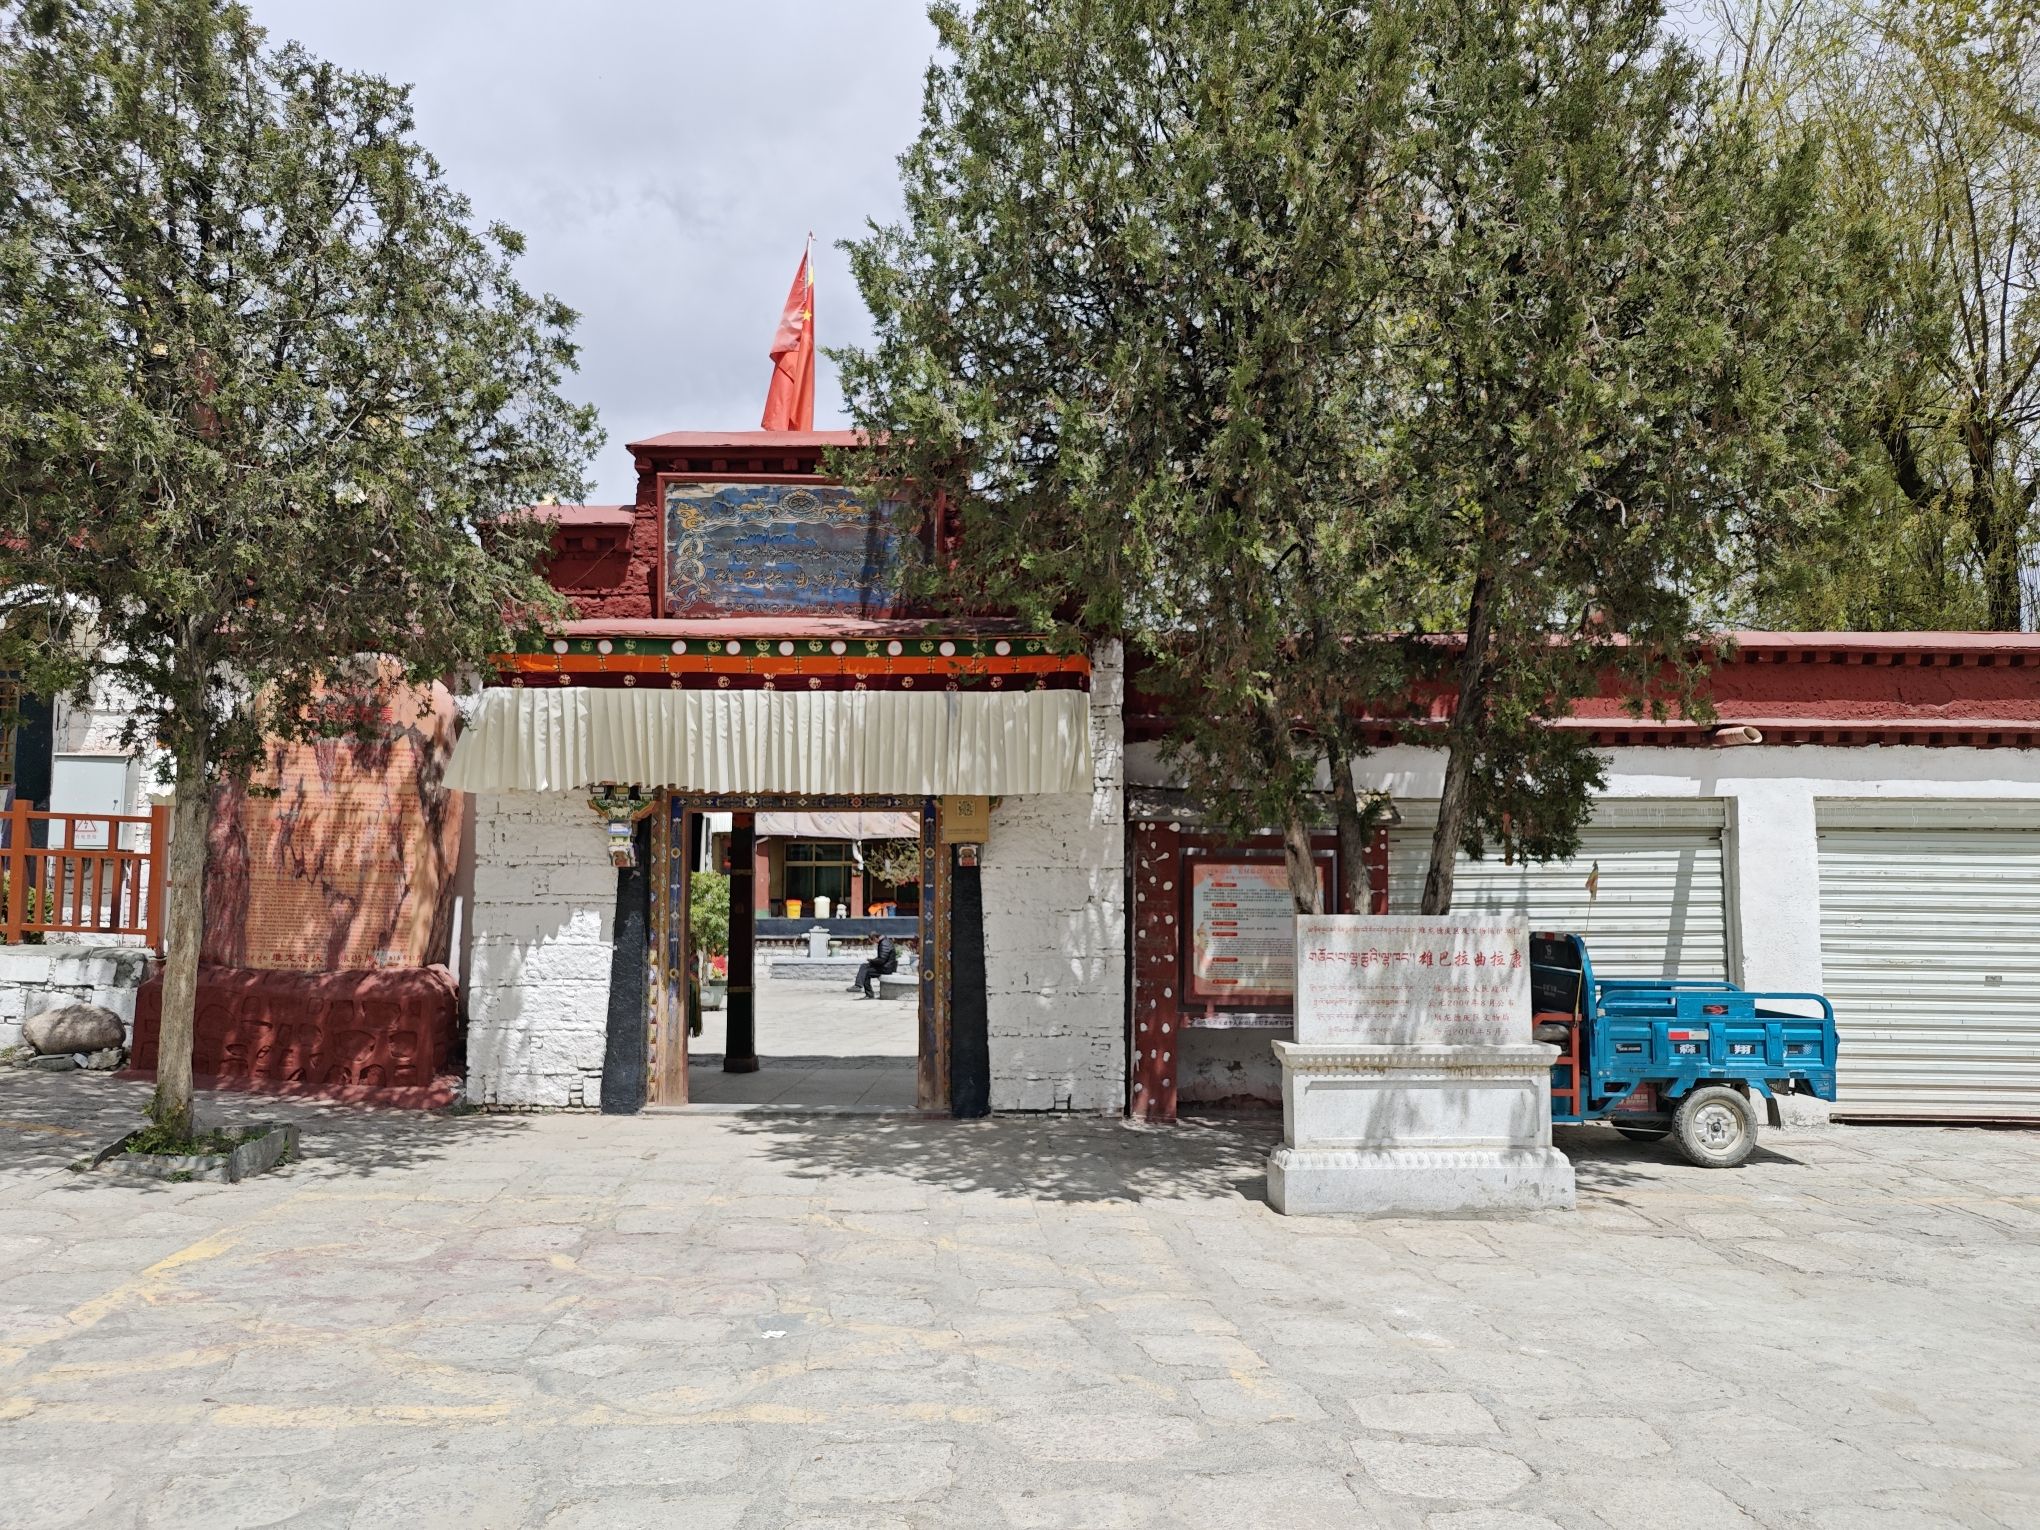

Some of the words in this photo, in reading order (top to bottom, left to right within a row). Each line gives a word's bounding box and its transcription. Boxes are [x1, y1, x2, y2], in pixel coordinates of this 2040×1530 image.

[1418, 948, 1522, 969] 雄巴拉曲拉康
[1679, 1044, 1696, 1054] 森
[1734, 1044, 1751, 1055] 翔
